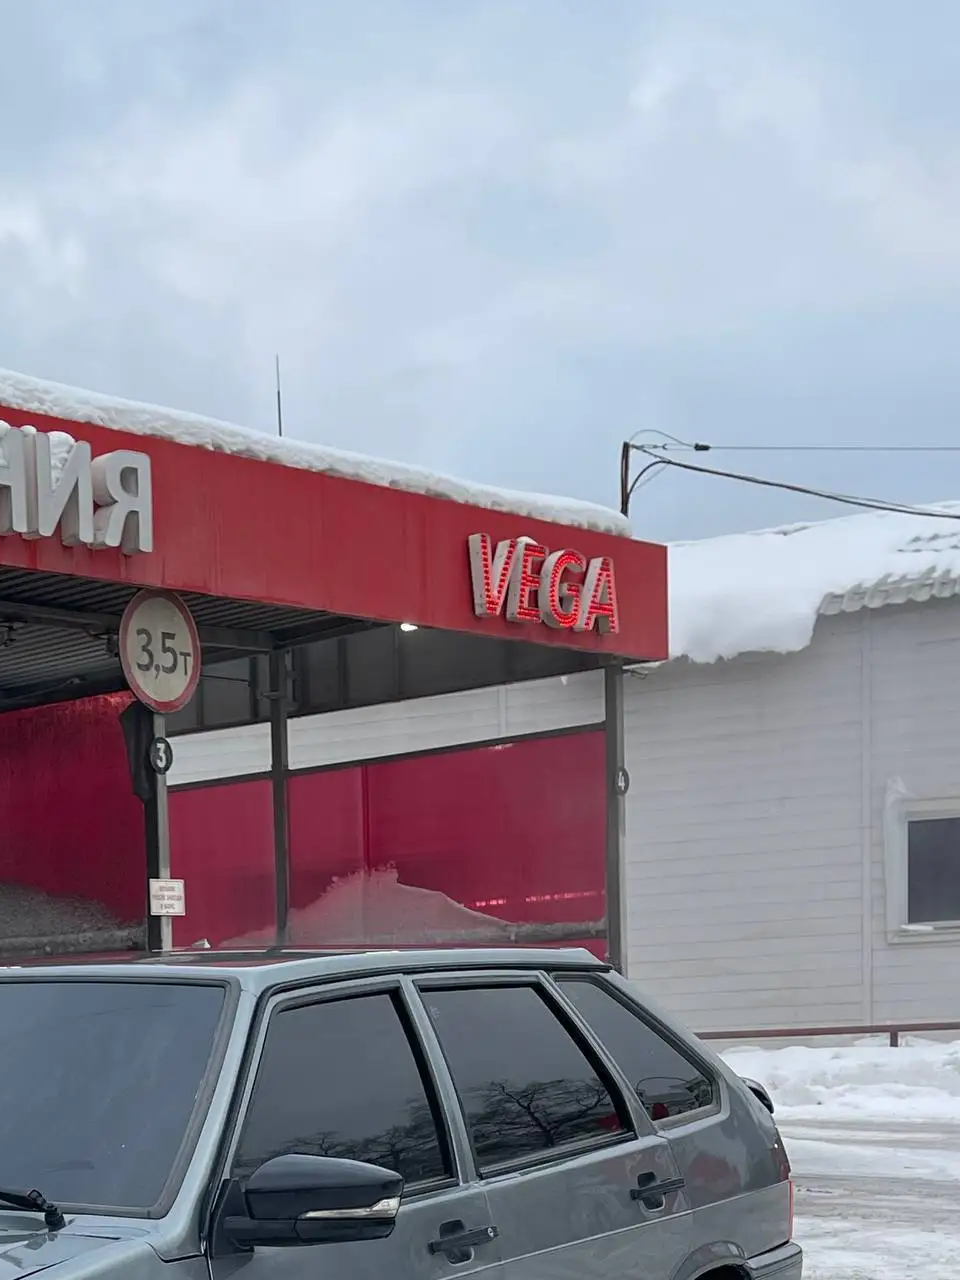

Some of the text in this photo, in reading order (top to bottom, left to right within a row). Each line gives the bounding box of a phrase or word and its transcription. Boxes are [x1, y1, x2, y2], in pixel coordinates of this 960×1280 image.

[468, 532, 619, 634] VEGA
[156, 743, 166, 769] 3
[618, 772, 625, 791] 4
